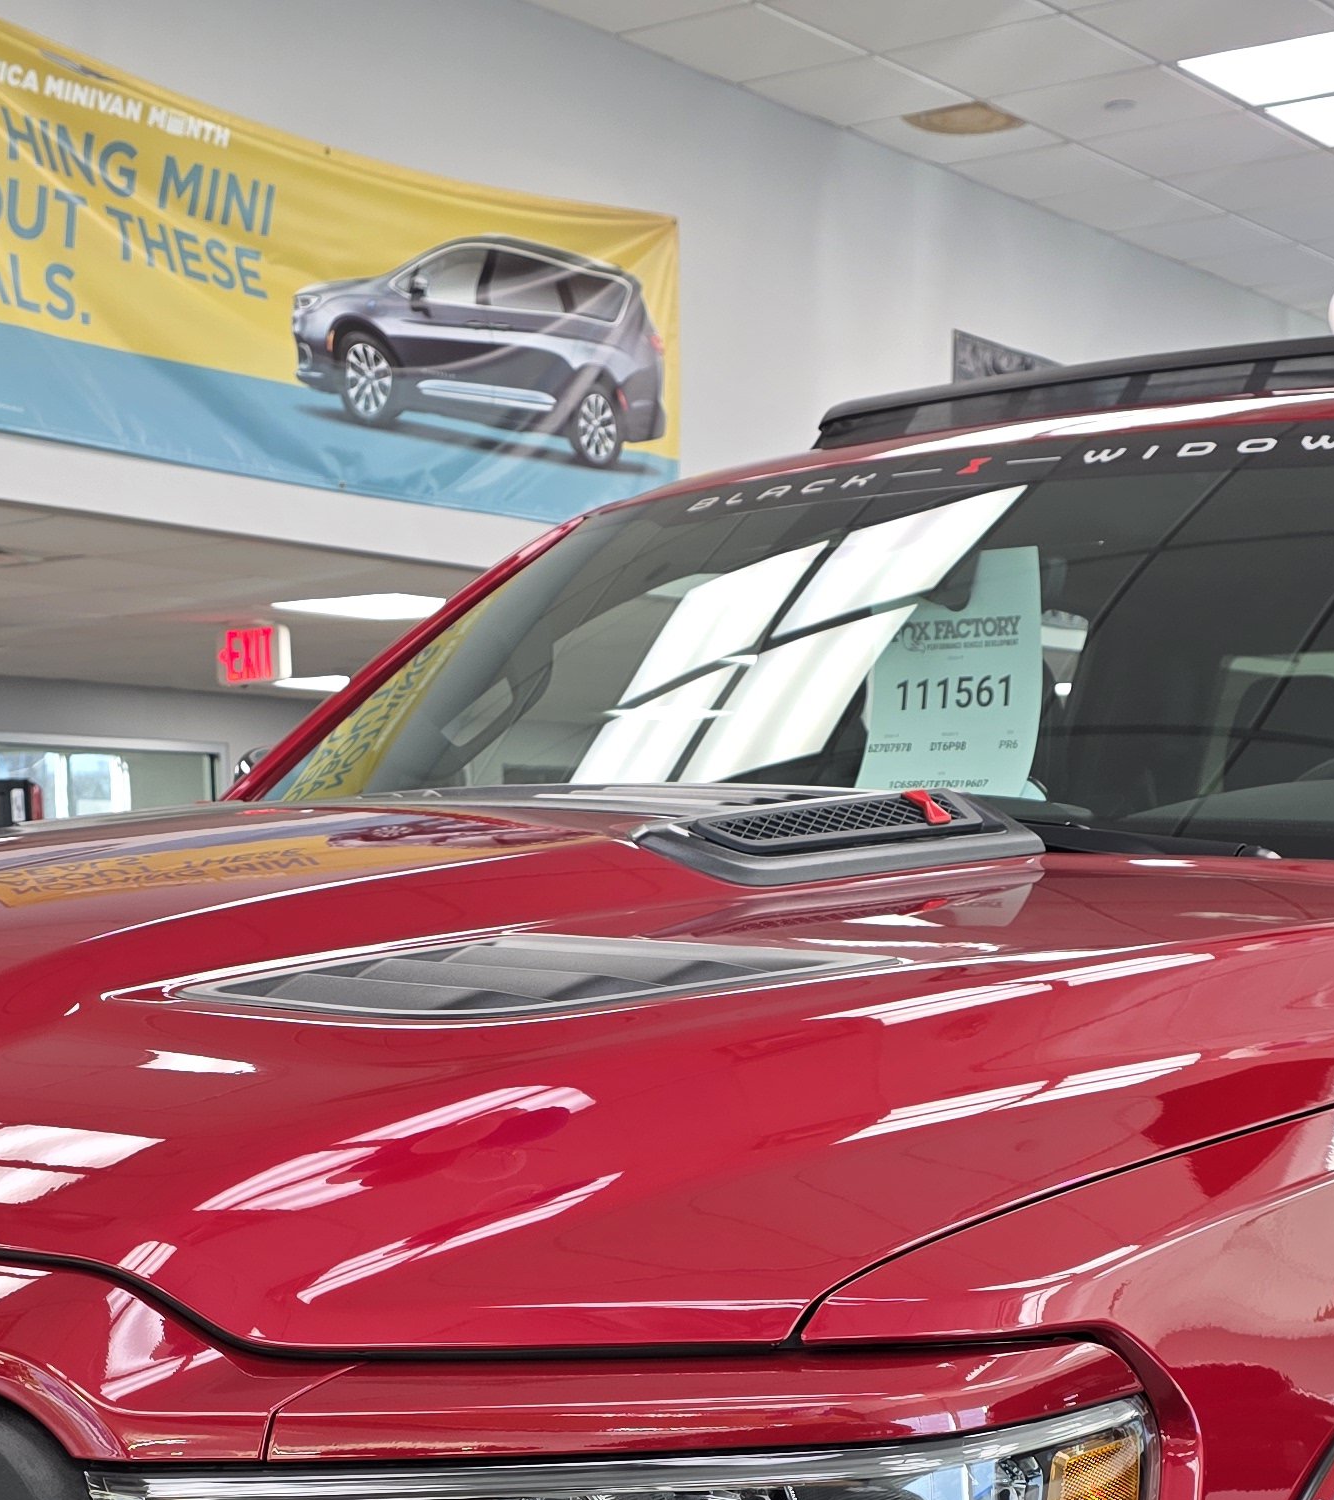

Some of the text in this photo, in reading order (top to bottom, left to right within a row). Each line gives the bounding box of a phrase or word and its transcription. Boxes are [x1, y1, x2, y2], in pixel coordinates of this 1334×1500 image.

[45, 73, 143, 123] MINIVAN
[158, 154, 276, 237] MINI
[105, 206, 269, 300] THESE
[687, 473, 877, 513] BLACK
[933, 615, 1022, 640] FACTORY
[225, 625, 274, 685] EXIT
[896, 673, 1012, 711] 111561
